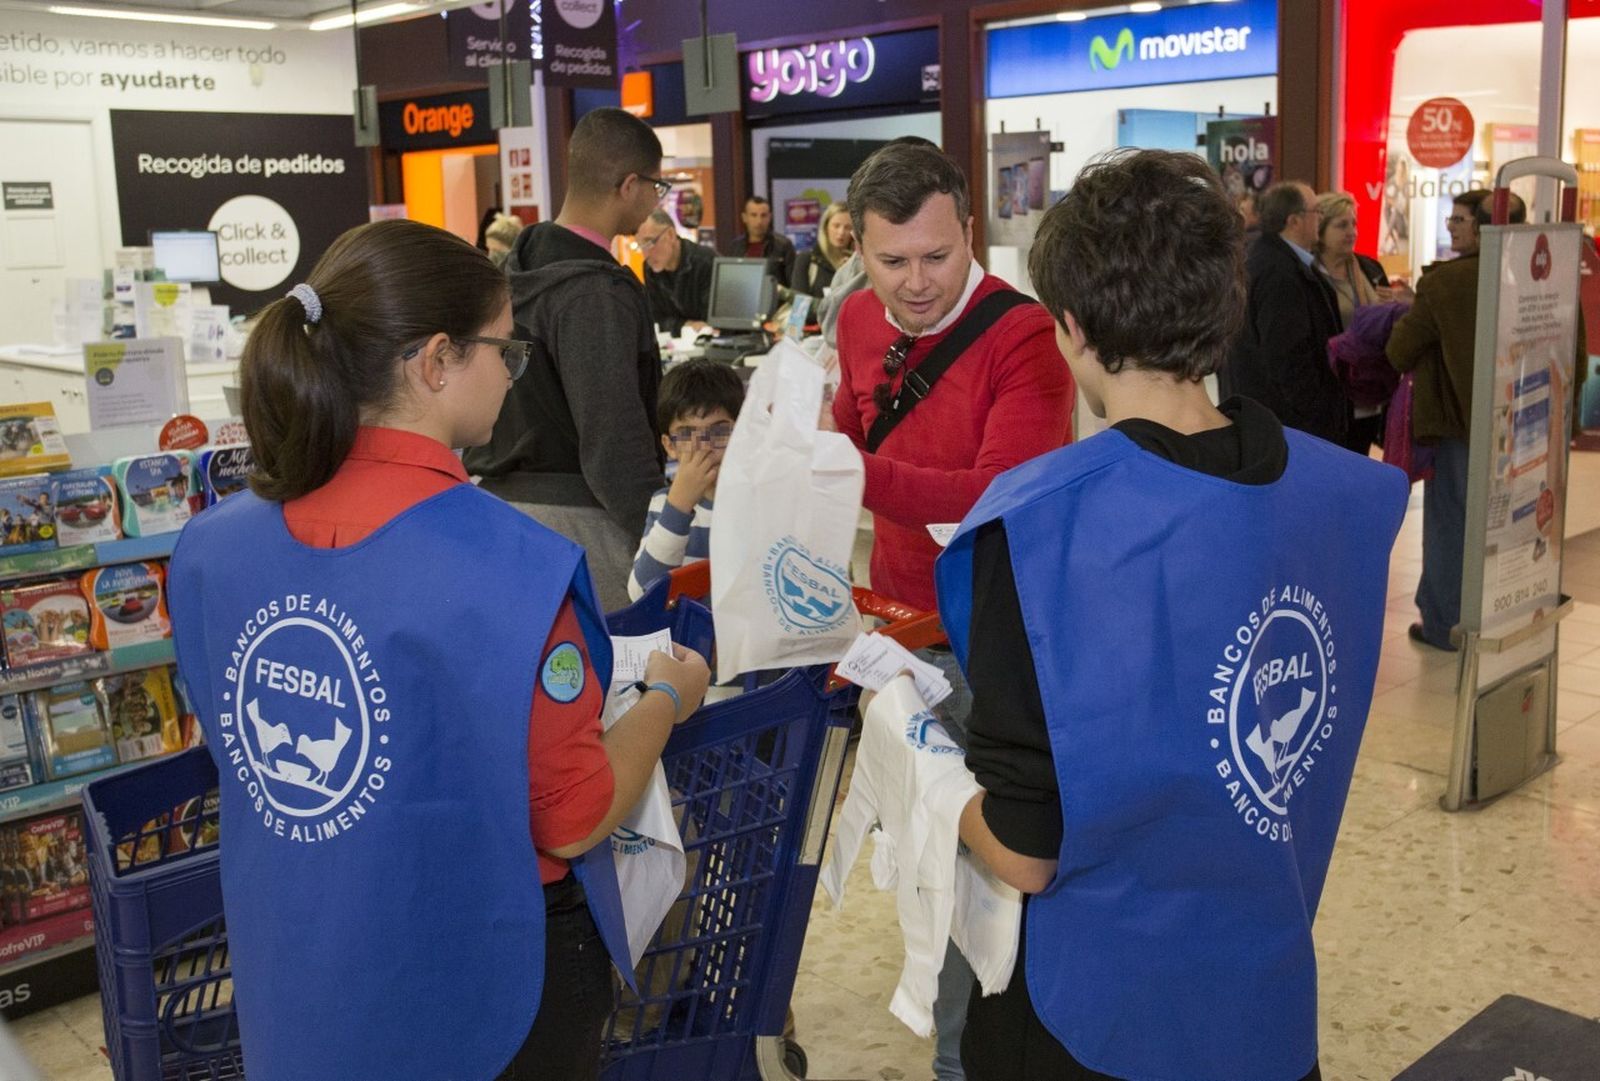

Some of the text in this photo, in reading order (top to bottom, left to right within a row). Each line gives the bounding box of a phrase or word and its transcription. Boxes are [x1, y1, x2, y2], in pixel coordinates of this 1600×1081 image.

[70, 39, 149, 58] vamos
[153, 44, 166, 59] a
[171, 41, 233, 63] hacer
[238, 45, 286, 65] todo
[467, 36, 516, 52] Servico
[555, 44, 607, 62] Recogida
[1140, 26, 1251, 60] movistar
[465, 54, 477, 67] al
[551, 61, 612, 76] de pedidos
[0, 62, 216, 91] ible por ayudarte
[404, 103, 473, 137] Orange
[1220, 137, 1269, 163] hola
[138, 153, 345, 178] Recogida de pedidos
[219, 223, 287, 242] Click &
[221, 246, 288, 265] collect
[786, 557, 840, 599] FESBAL
[225, 594, 391, 722] BANCOS DE ALIMENTOS
[1207, 585, 1337, 723] BANCOS DE ALIMENTOS
[255, 657, 346, 708] FESBAL
[220, 713, 264, 812] BANCOS
[263, 810, 285, 837] DE
[290, 755, 392, 844] ALIMENTOS
[1216, 758, 1279, 842] BANCOS
[0, 933, 46, 957] ofreVIP
